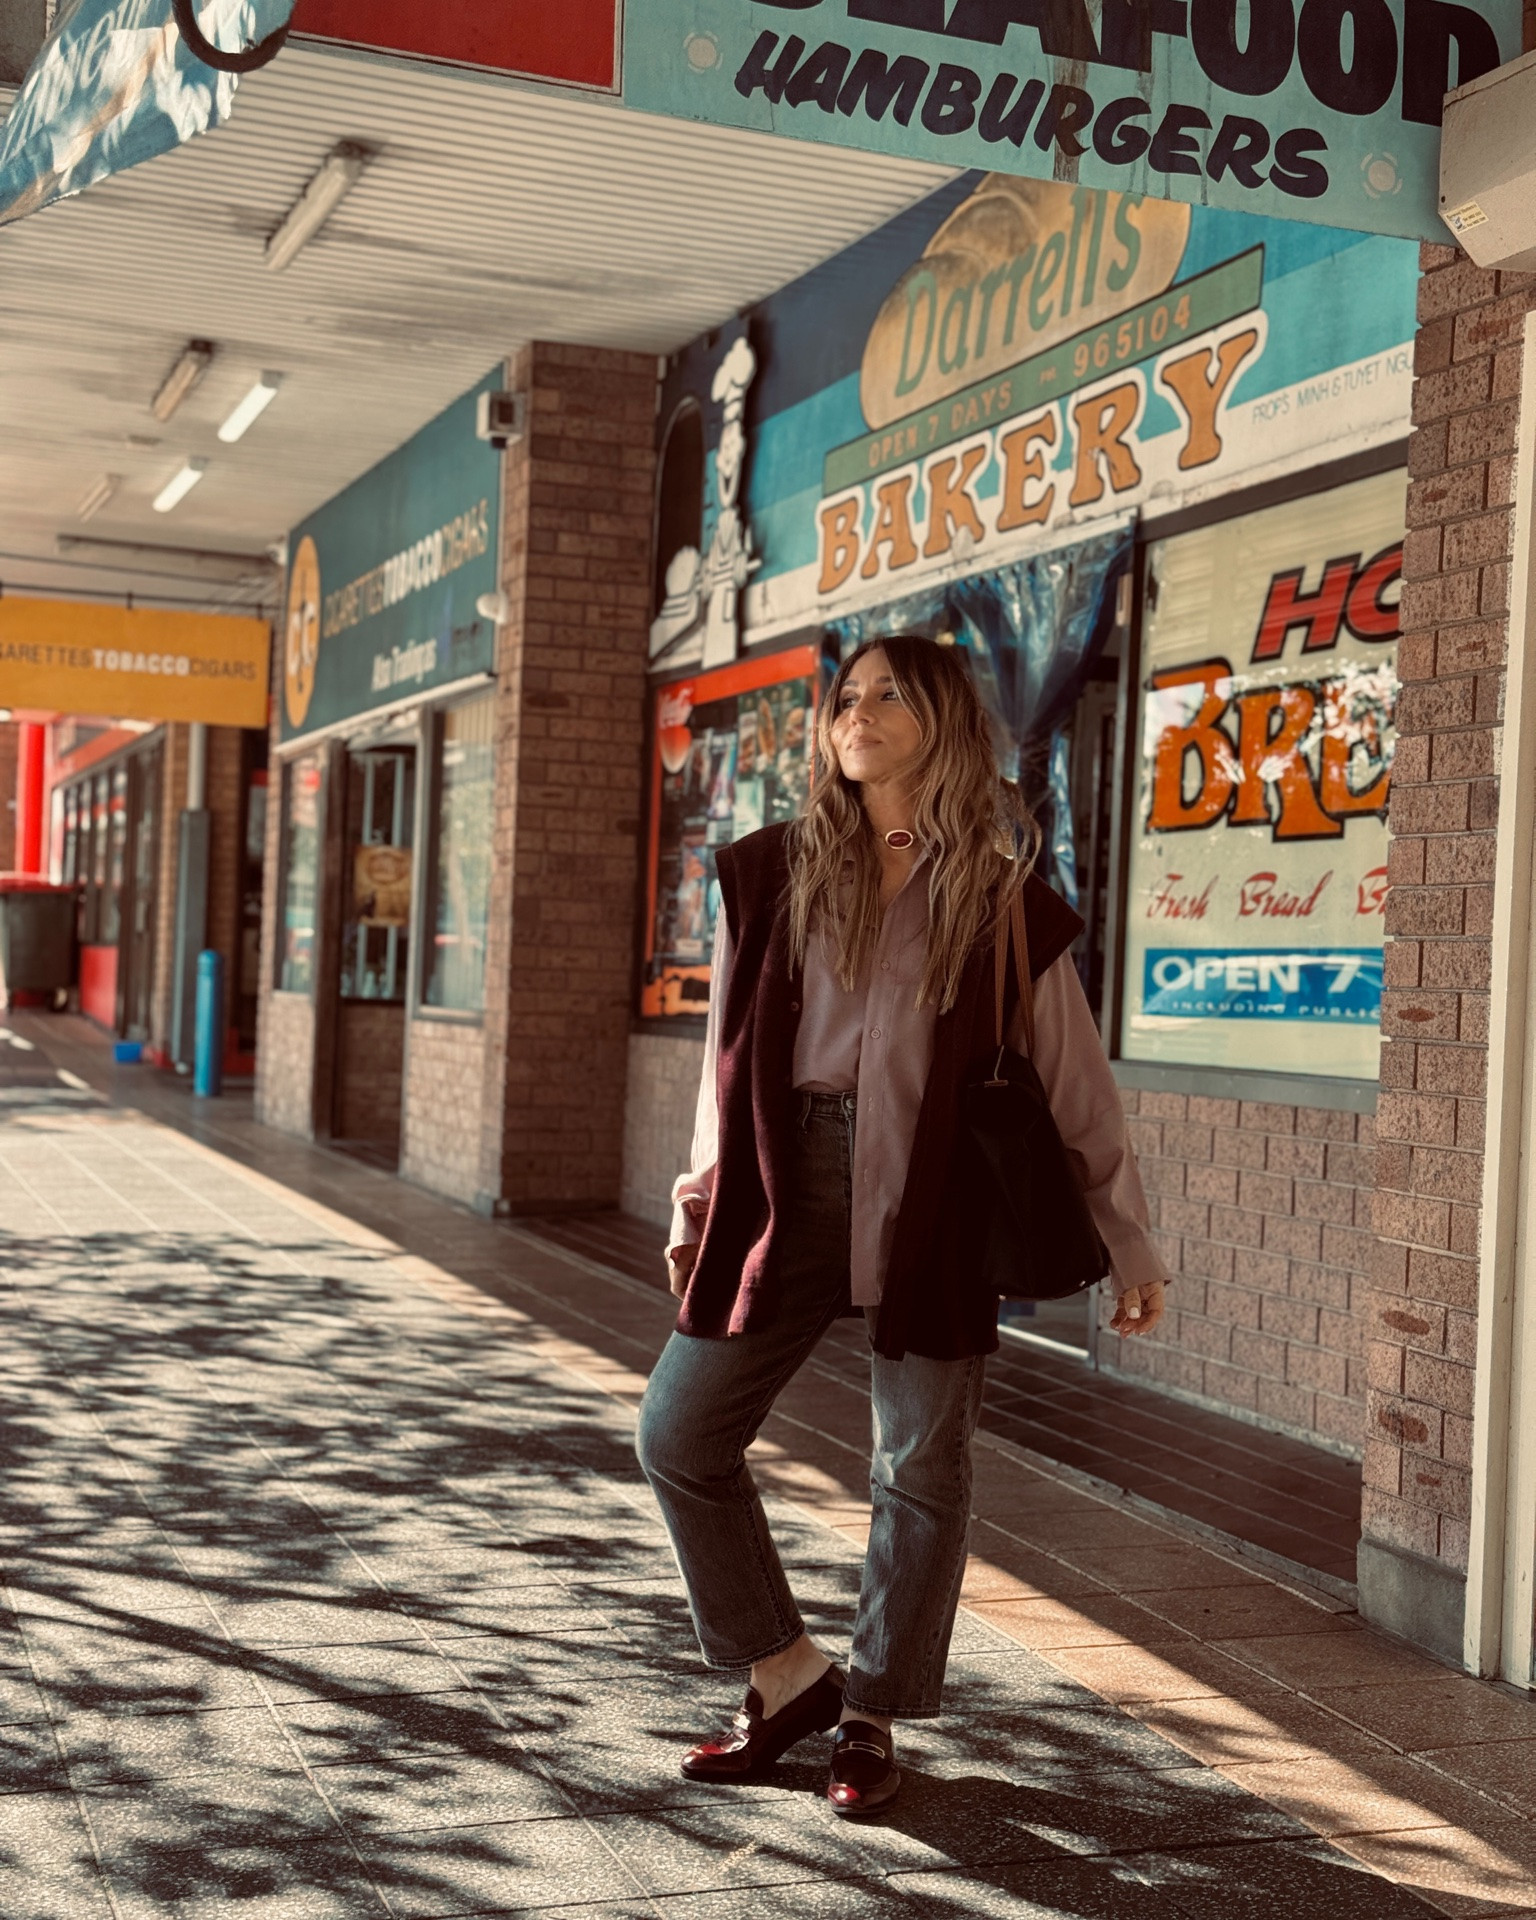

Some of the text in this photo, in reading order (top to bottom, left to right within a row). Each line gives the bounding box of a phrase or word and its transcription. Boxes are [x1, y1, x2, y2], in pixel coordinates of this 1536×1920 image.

[734, 29, 1329, 198] HAMBURGERS
[868, 424, 918, 469] OPEN
[928, 413, 939, 443] 7
[949, 380, 1013, 432] DAYS
[1073, 294, 1191, 379] 965104
[816, 327, 1258, 595] BAKERY
[0, 642, 93, 669] ARETTES
[92, 648, 190, 677] TOBACCO
[1146, 872, 1219, 920] Fresh
[1235, 869, 1334, 921] Bread
[1152, 955, 1362, 993] OPEN 7
[1173, 1000, 1381, 1019] INCLUDING PUBLIC
